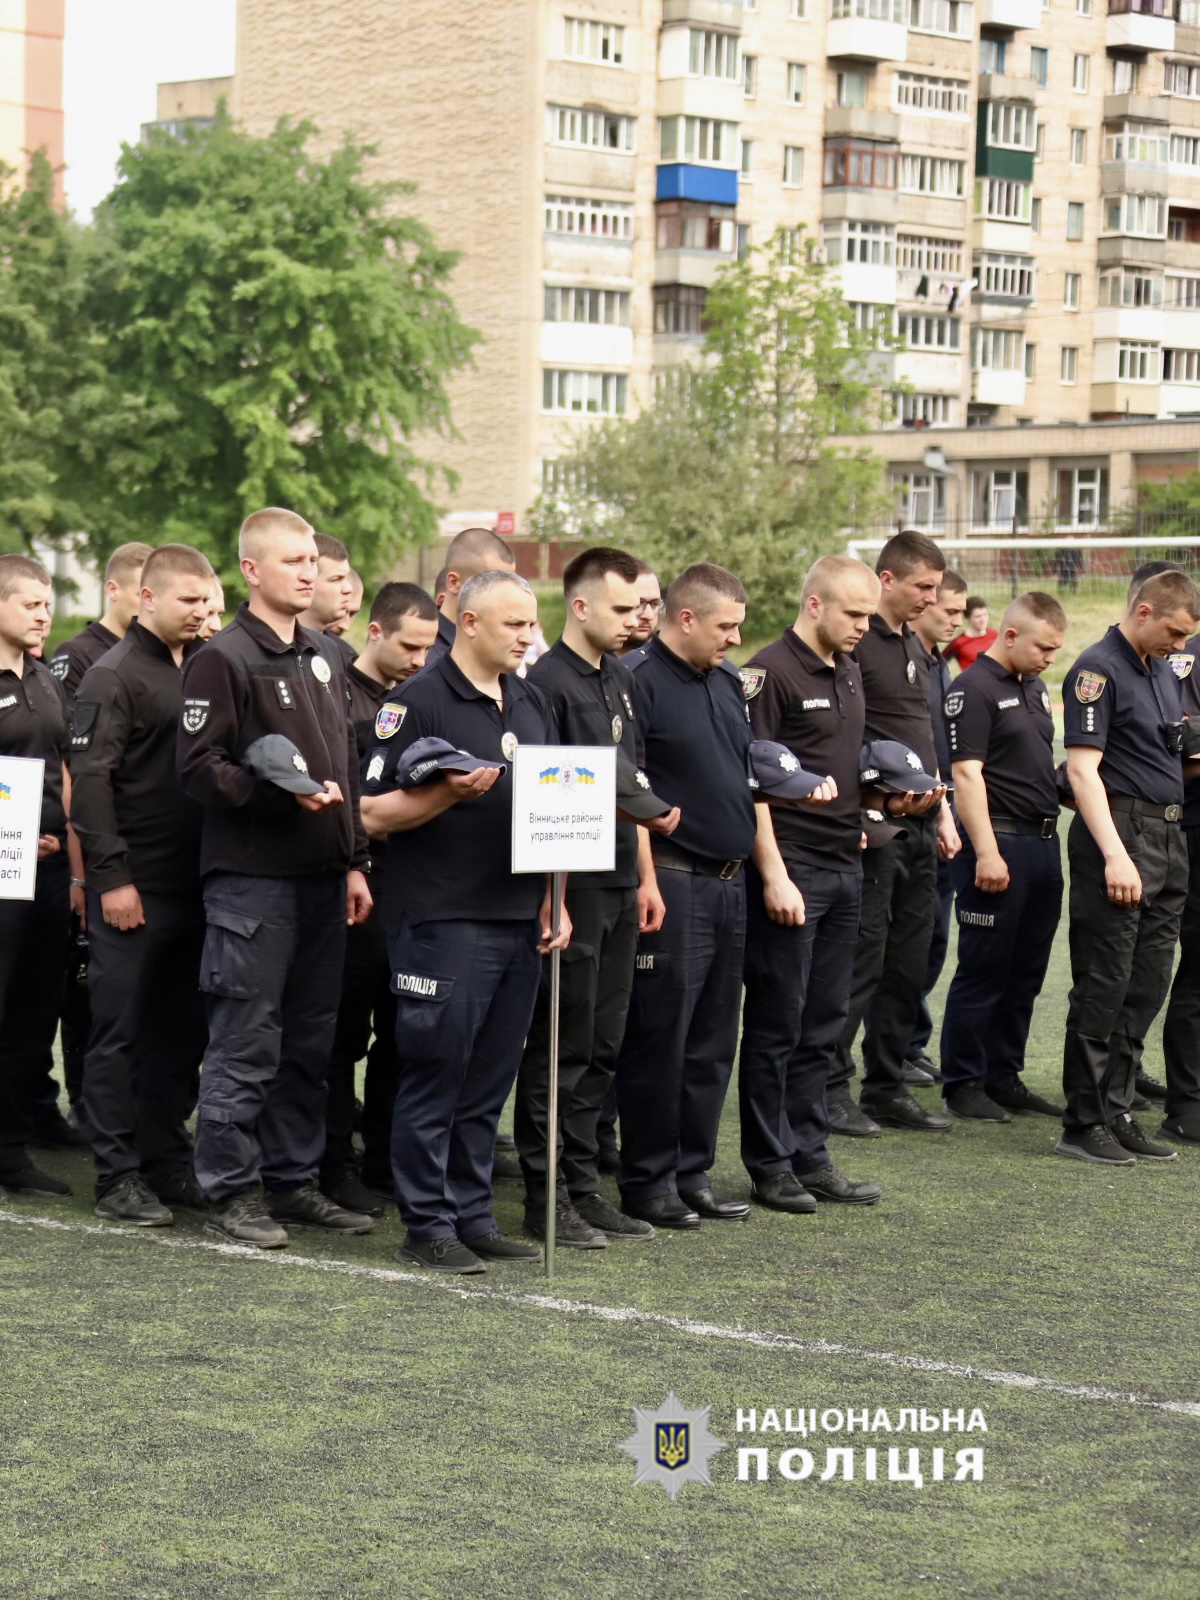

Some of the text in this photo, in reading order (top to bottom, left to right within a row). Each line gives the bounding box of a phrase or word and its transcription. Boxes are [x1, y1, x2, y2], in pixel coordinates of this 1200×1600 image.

[529, 811, 603, 826] Вінницьке районне
[530, 828, 602, 844] управління поліції
[960, 910, 995, 928] ПОЛІЦІЯ
[397, 973, 438, 996] ПОЛІЦІЯ
